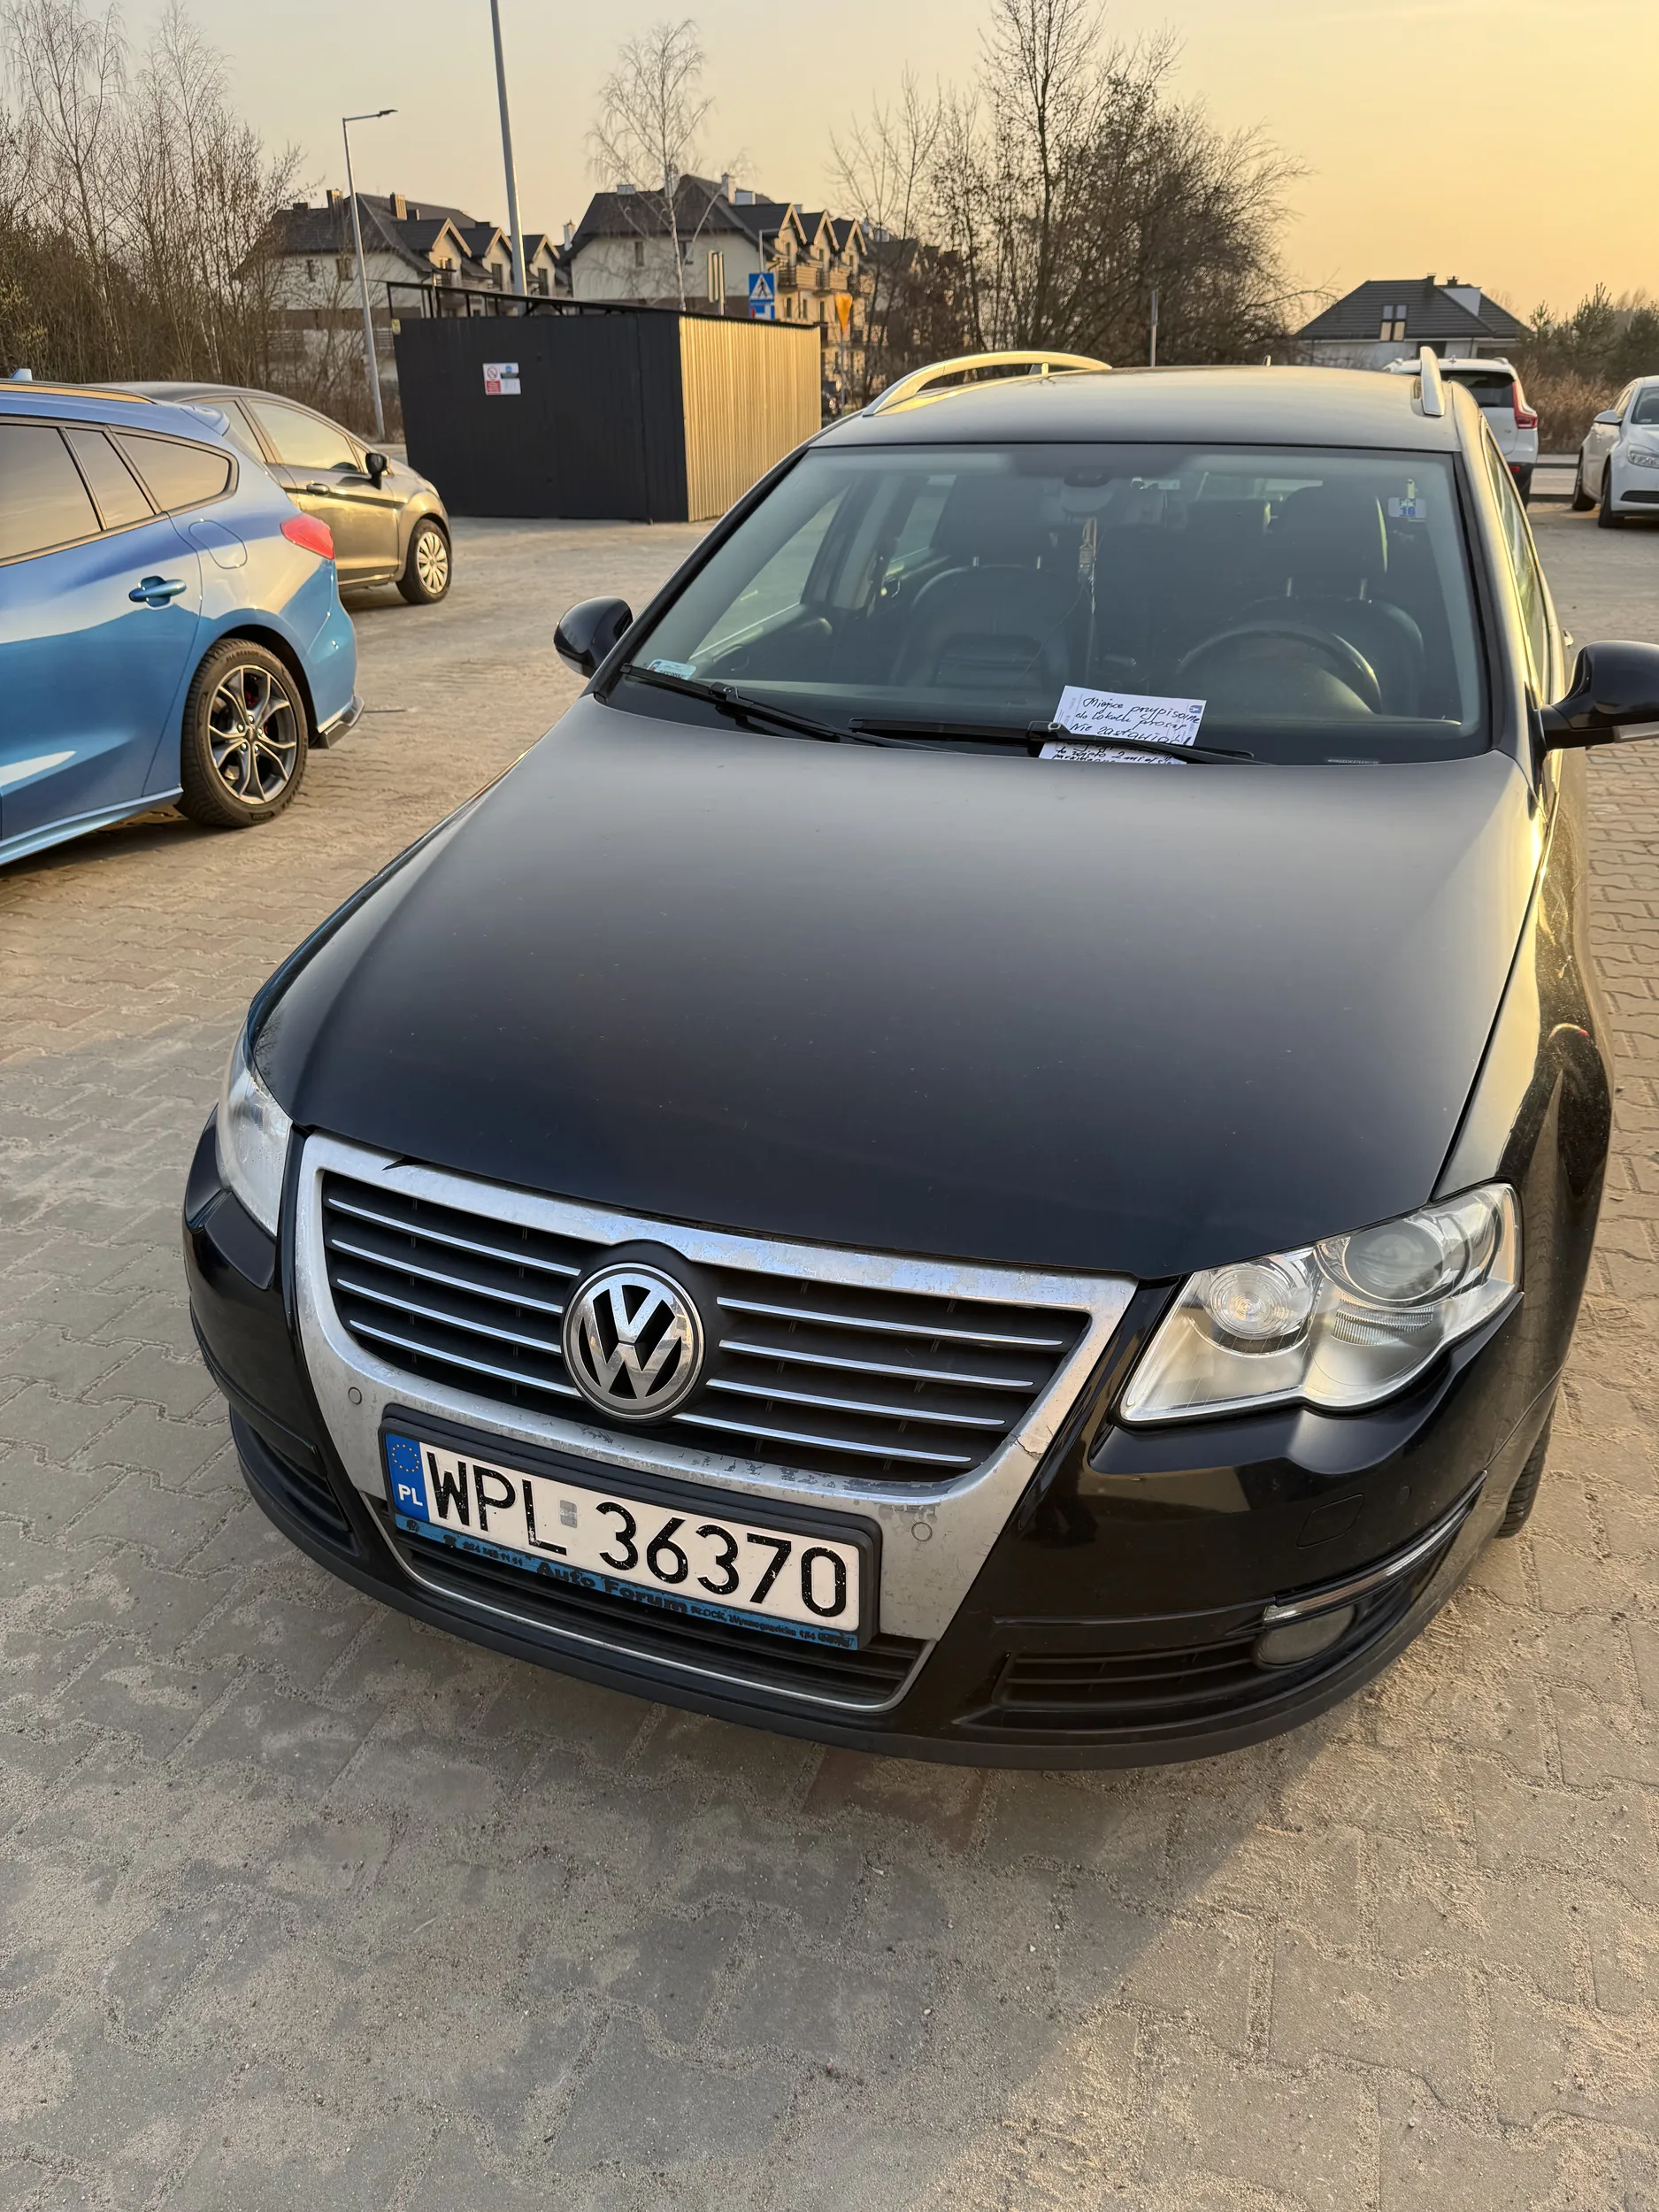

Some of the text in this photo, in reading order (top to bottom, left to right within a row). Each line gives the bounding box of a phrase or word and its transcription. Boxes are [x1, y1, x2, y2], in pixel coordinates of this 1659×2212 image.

[397, 1484, 424, 1507] PL
[426, 1451, 847, 1617] WPL 36370
[536, 1561, 596, 1587] Auto
[604, 1578, 688, 1613] Forum
